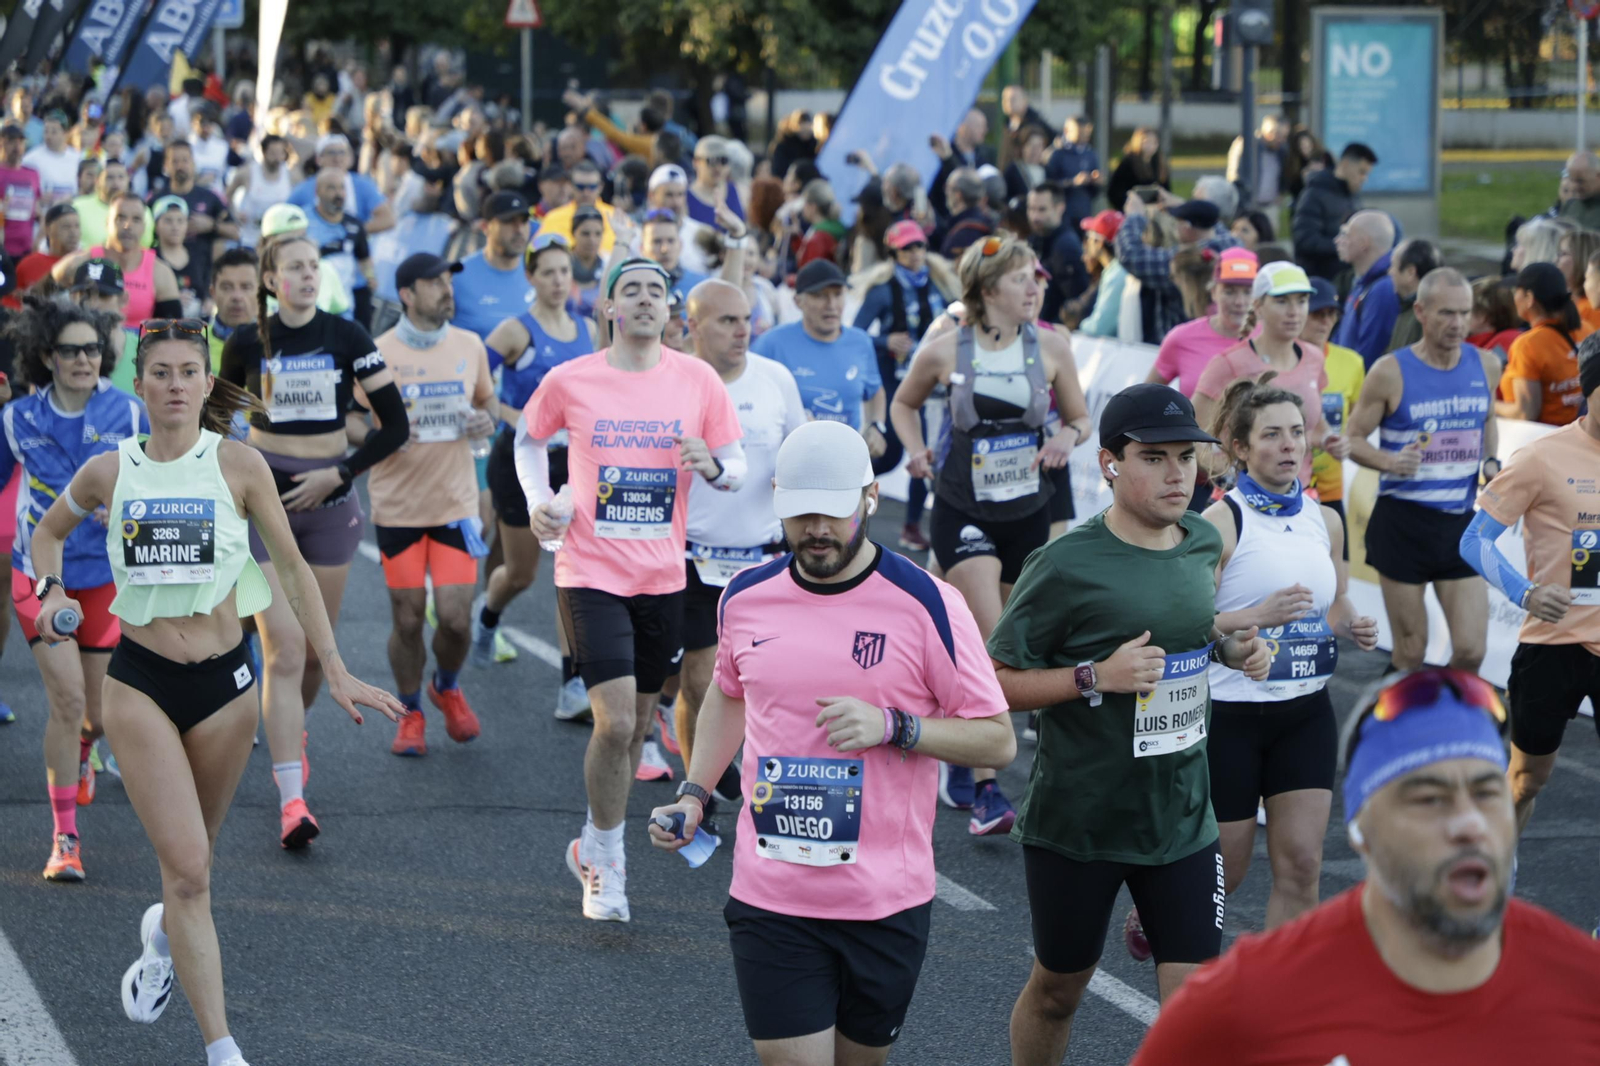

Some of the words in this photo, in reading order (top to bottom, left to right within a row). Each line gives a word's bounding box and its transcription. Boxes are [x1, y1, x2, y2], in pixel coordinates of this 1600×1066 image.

[1331, 42, 1392, 78] NO
[286, 358, 326, 370] ZURICH
[274, 390, 323, 406] SARICA
[424, 385, 460, 397] ZURICH
[594, 419, 674, 433] ENERGY
[1440, 418, 1476, 430] ZURICH
[591, 434, 675, 449] RUNNING
[994, 436, 1030, 451] ZURICH
[625, 471, 669, 482] ZURICH
[622, 491, 652, 504] 13034
[151, 503, 203, 515] ZURICH
[605, 504, 665, 522] RUBENS
[152, 527, 180, 540] 3263
[134, 544, 201, 564] MARINE
[1289, 622, 1323, 633] ZURICH
[1289, 644, 1318, 657] 14659
[1291, 660, 1316, 678] FRA
[1168, 685, 1197, 702] 11578
[1135, 715, 1168, 733] LUIS
[787, 764, 849, 780] ZURICH
[783, 795, 824, 811] 13156
[775, 814, 834, 840] DIEGO
